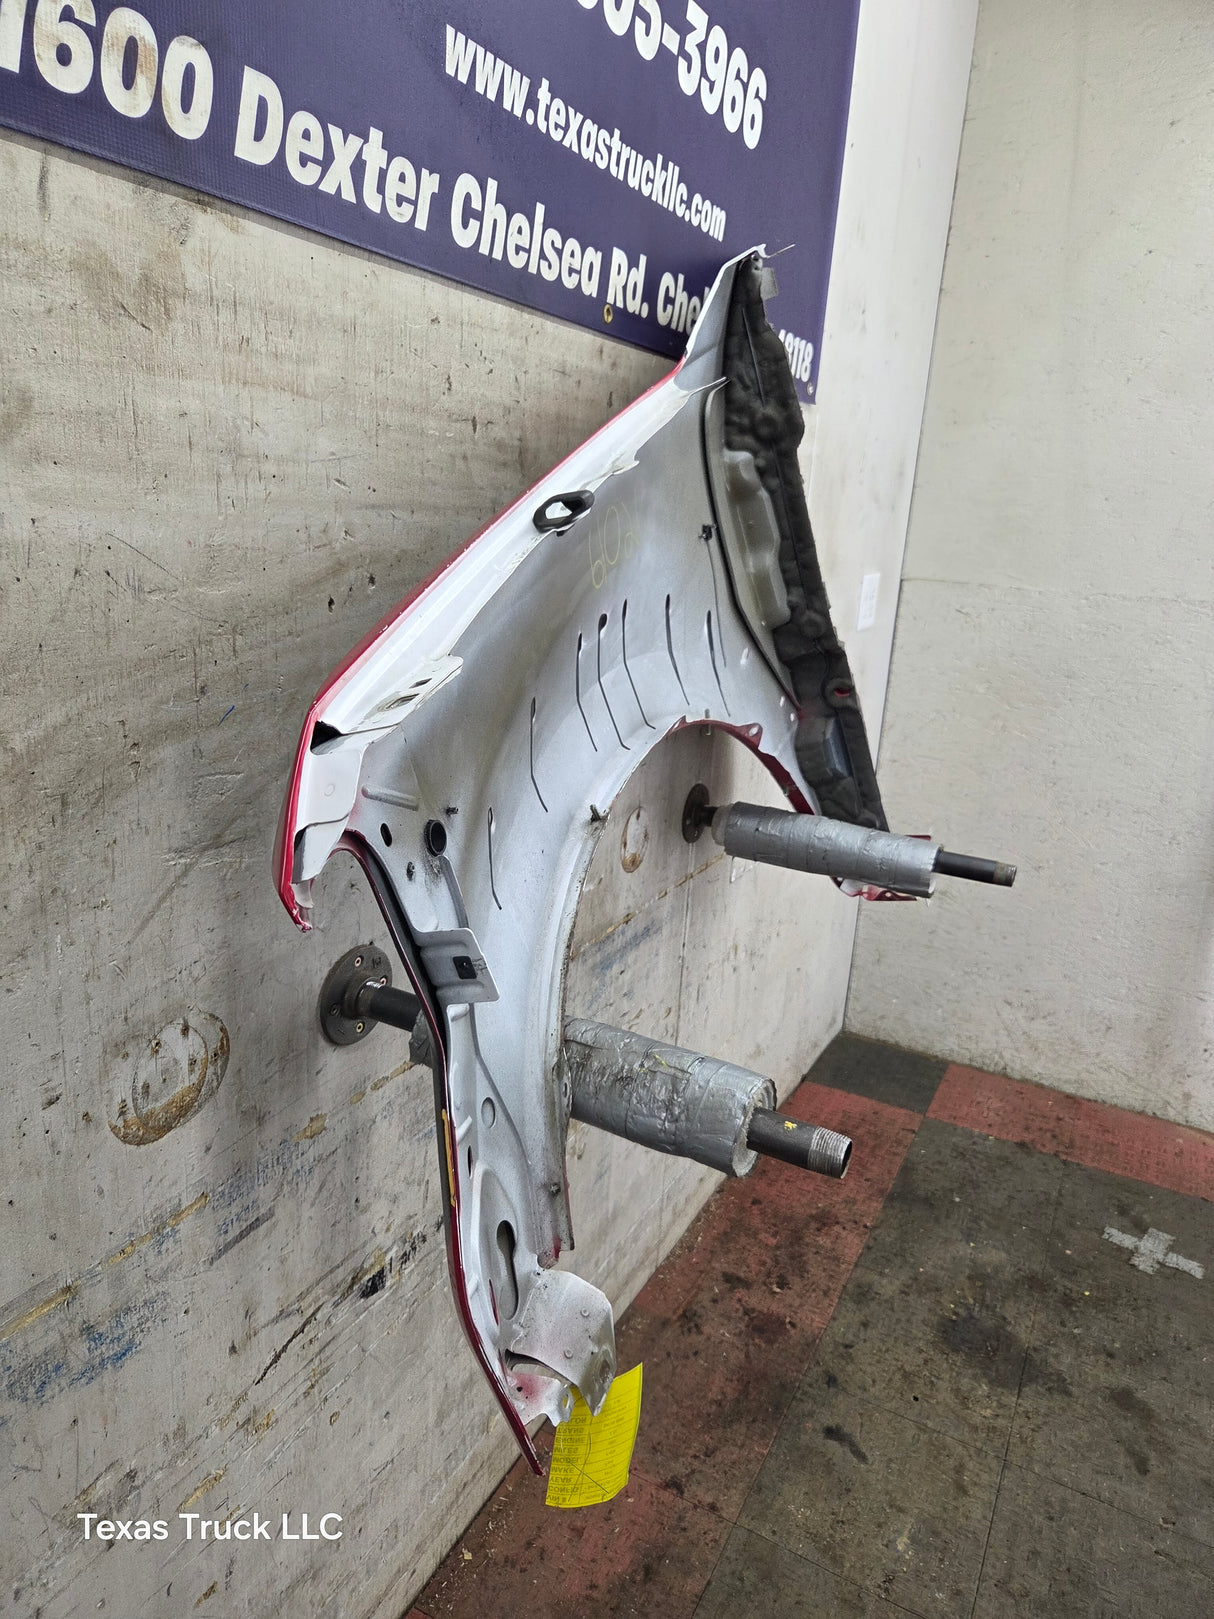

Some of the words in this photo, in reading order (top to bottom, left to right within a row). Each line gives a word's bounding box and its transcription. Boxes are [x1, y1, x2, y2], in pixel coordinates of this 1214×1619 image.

[446, 24, 727, 242] www.texastruckllc.com
[577, 0, 767, 150] 5-3966
[234, 65, 440, 232] Dexter
[451, 172, 602, 298] Chelsea
[606, 246, 649, 319] Rd.
[657, 271, 711, 337] Che
[778, 329, 814, 383] 8118
